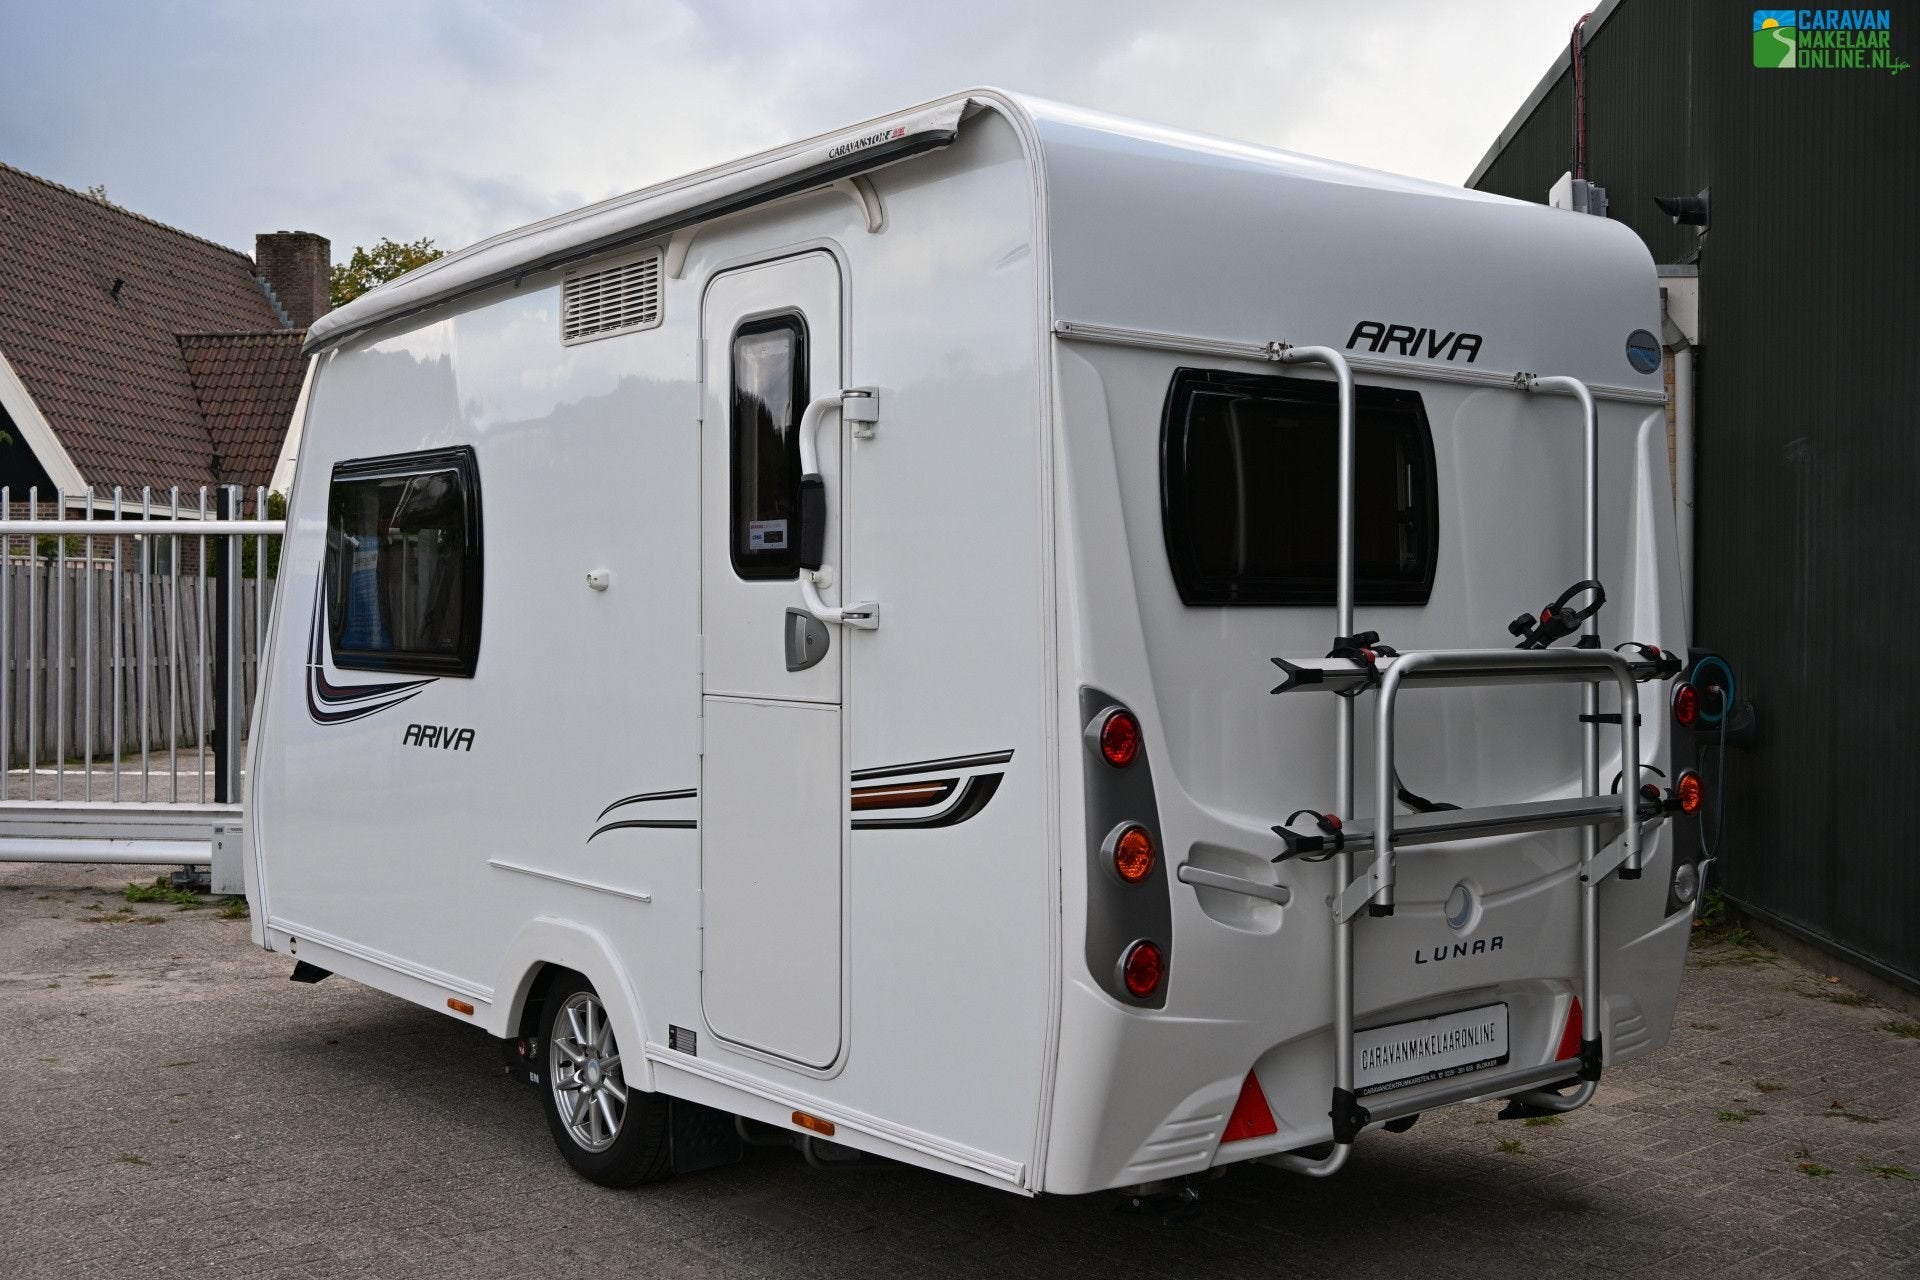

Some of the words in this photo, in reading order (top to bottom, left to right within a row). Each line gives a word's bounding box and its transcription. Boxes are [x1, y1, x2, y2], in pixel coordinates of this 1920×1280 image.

[1346, 321, 1483, 363] ARIVA
[403, 724, 475, 752] ARIVA
[1415, 936, 1504, 964] LUNAR
[1361, 1022, 1495, 1070] CARAVANMAKELAARONLINE
